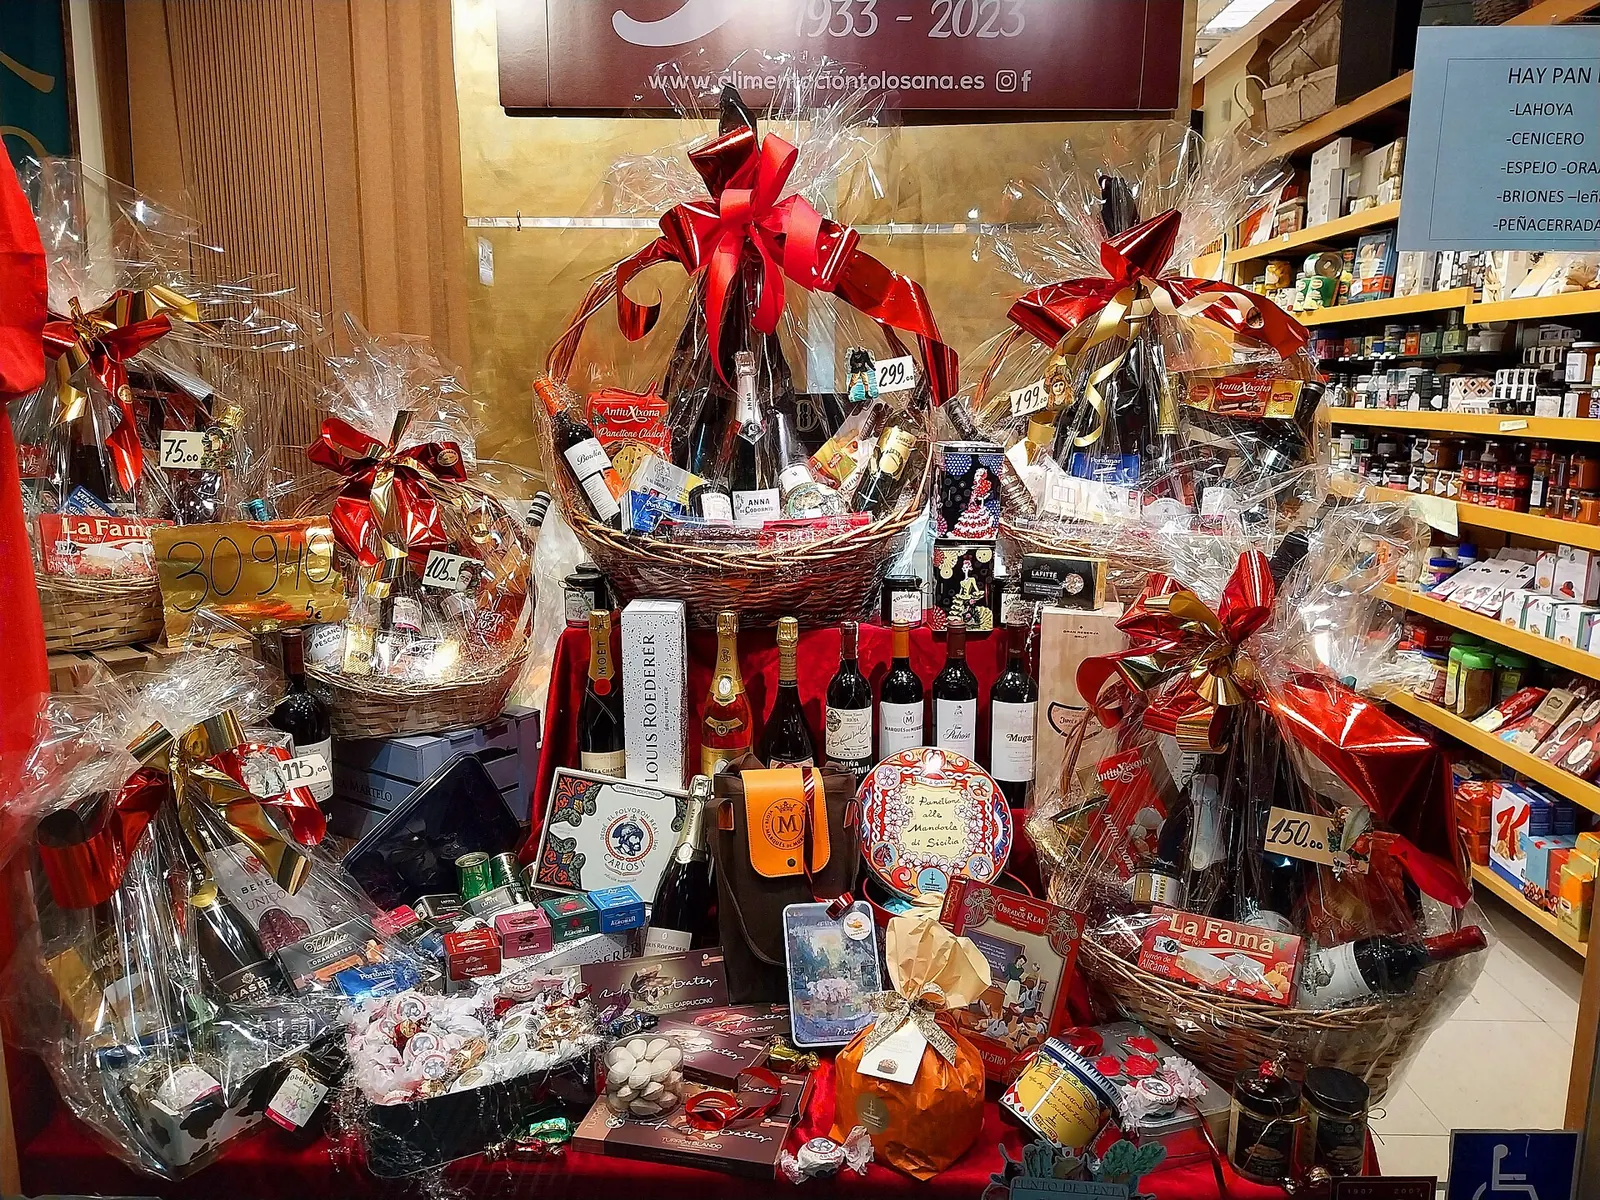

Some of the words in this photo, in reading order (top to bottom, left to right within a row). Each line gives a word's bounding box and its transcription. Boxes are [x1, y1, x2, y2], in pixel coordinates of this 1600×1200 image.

[794, 0, 879, 39] 1933
[927, 0, 1027, 39] 2023
[1508, 67, 1547, 84] HAY
[1552, 67, 1592, 84] PAN
[1509, 103, 1574, 116] -LAHOYA
[1506, 132, 1585, 145] -CENICERO
[1500, 161, 1557, 174] -ESPEJO
[1561, 161, 1600, 174] -ORA
[1496, 190, 1564, 203] -BRIONES
[603, 405, 660, 423] AntiuXixona
[748, 498, 770, 506] ANNA
[62, 517, 91, 535] La
[1031, 570, 1058, 579] LAFITTE
[643, 634, 658, 728] ROEDERER
[1006, 733, 1035, 743] Muga
[645, 733, 659, 784] LOUIS
[352, 784, 393, 802] MARTELO
[777, 814, 799, 834] M
[911, 838, 921, 847] di
[926, 838, 960, 848] Sicilia
[603, 853, 639, 871] CARLOS
[998, 903, 1025, 919] OBRADOR
[1027, 912, 1045, 925] REAL
[1168, 913, 1198, 938] La
[1203, 920, 1275, 953] Fama
[312, 944, 353, 966] ORANGETTES
[674, 997, 714, 1009] CAPPUCCINO
[979, 1050, 1006, 1066] AESTRA
[1013, 1178, 1058, 1191] PUNTO
[1063, 1182, 1078, 1193] DE
[1083, 1184, 1126, 1197] VENTA
[1394, 1187, 1421, 1195] 2007
